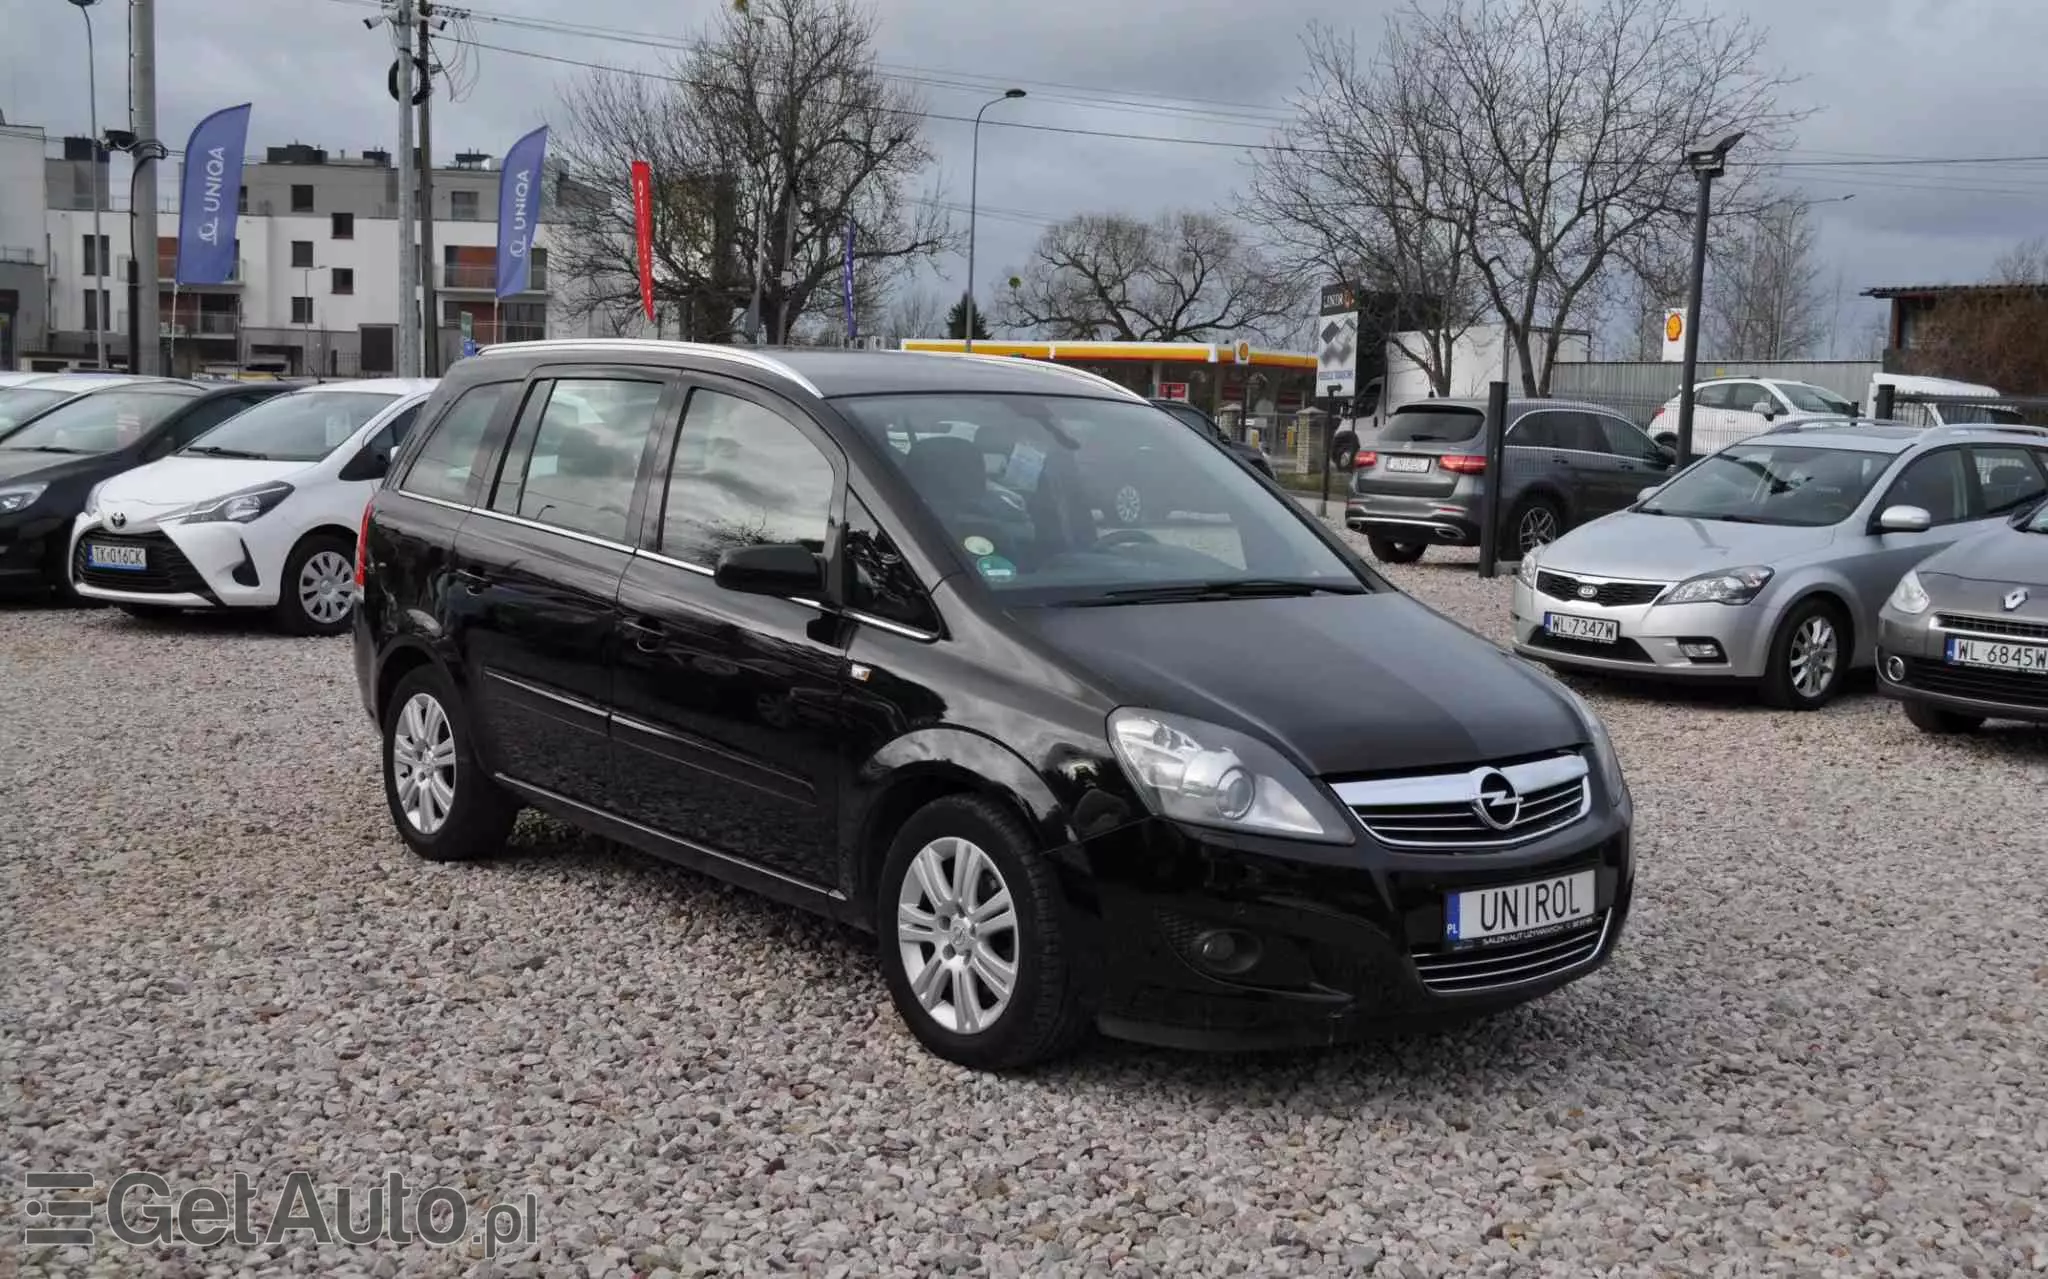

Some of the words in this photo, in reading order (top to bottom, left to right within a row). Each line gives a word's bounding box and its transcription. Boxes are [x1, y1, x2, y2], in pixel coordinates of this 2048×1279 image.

[204, 147, 225, 212] UNIQA
[514, 170, 529, 230] UNIQA
[1572, 618, 1615, 639] 7347W
[1987, 644, 2047, 668] 6845W
[1481, 878, 1580, 932] UNIROL
[1446, 923, 1458, 935] PL
